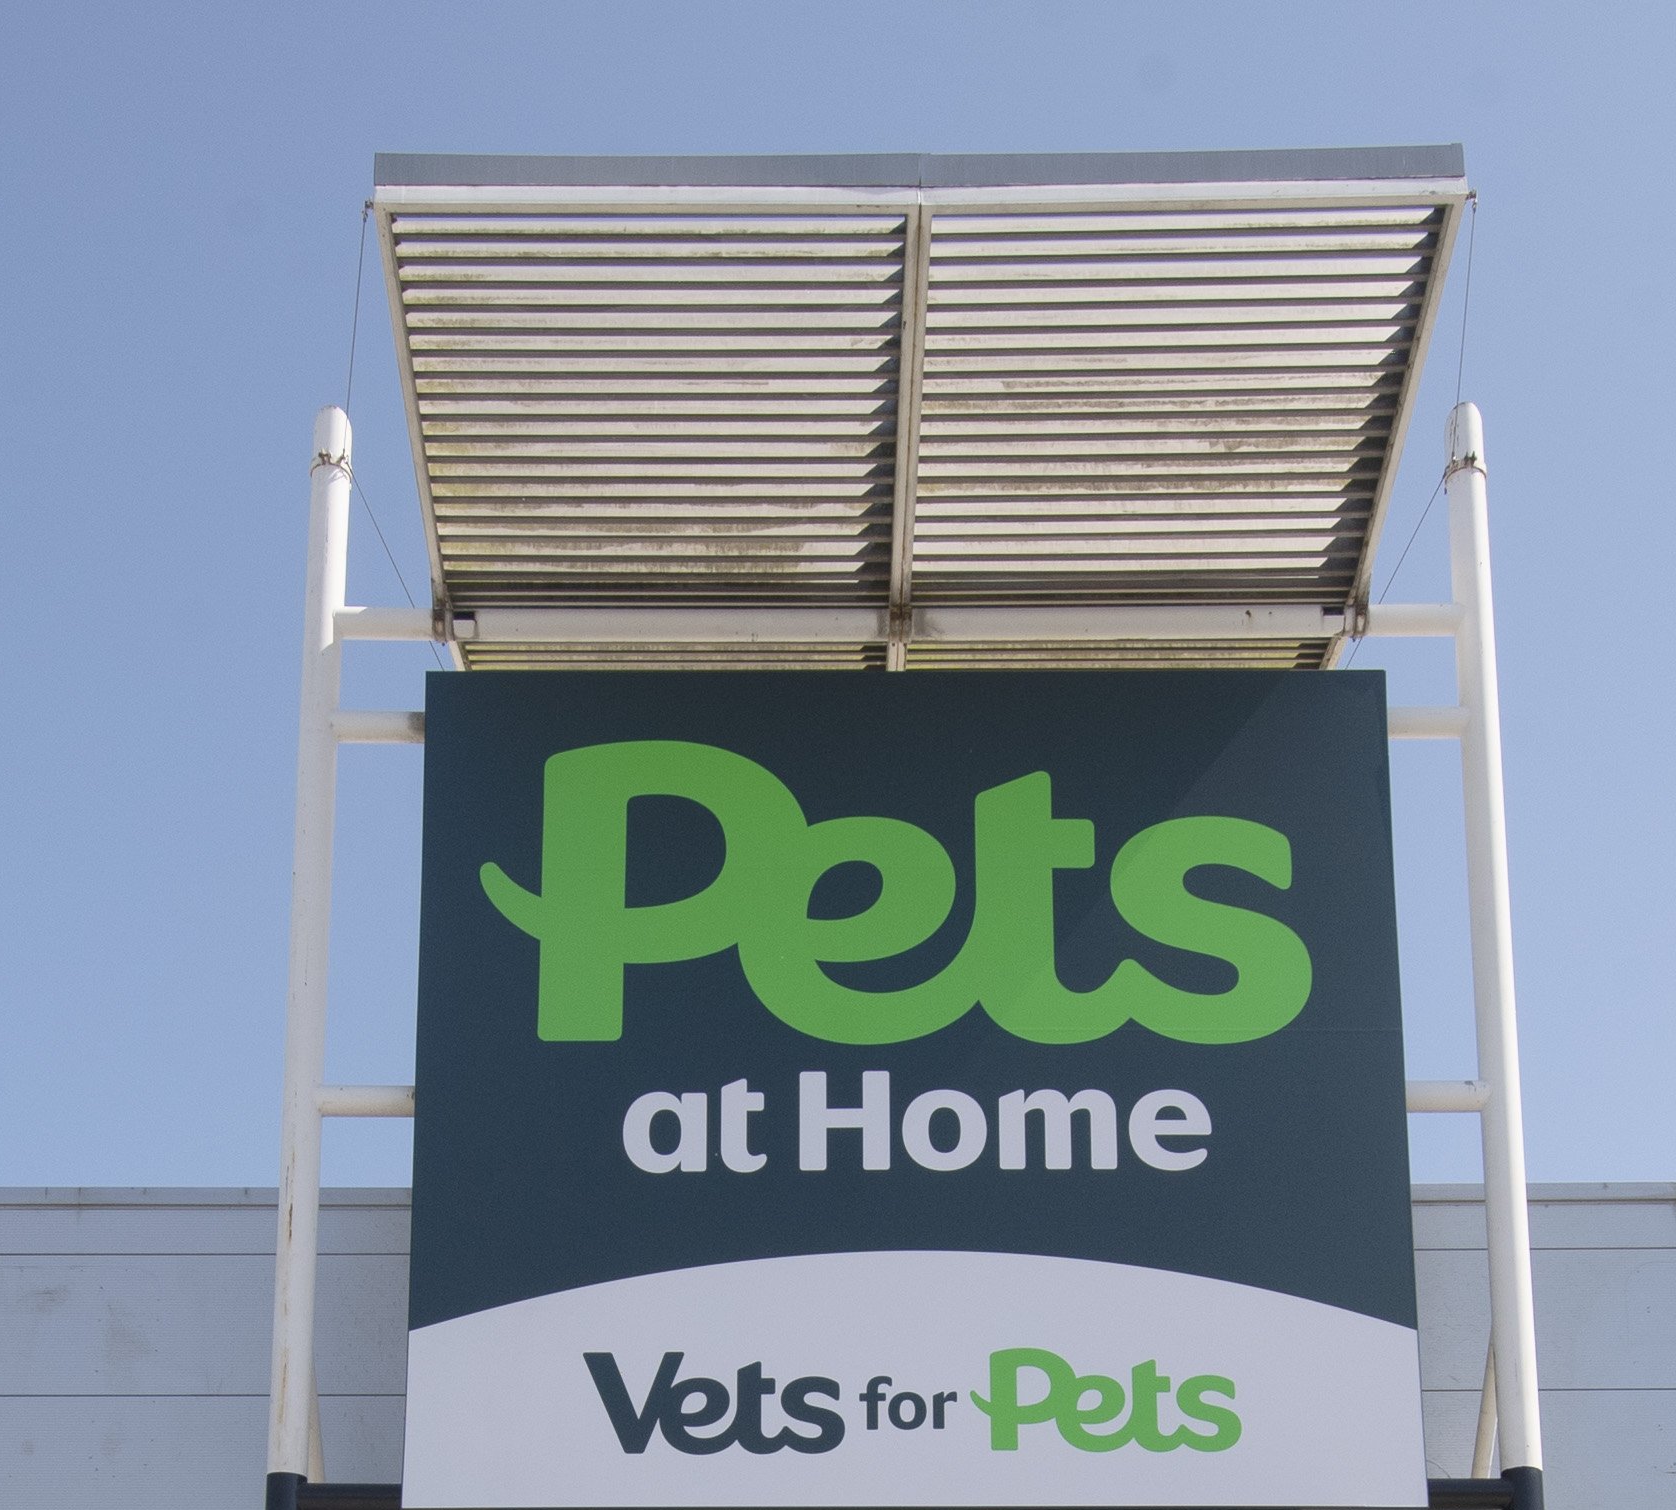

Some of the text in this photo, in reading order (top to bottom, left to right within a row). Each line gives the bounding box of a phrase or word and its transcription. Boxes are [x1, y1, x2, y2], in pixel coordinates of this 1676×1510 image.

[480, 740, 1312, 1045] Pets
[622, 1071, 1212, 1173] at Home
[583, 1348, 1242, 1455] Vets for Pets
